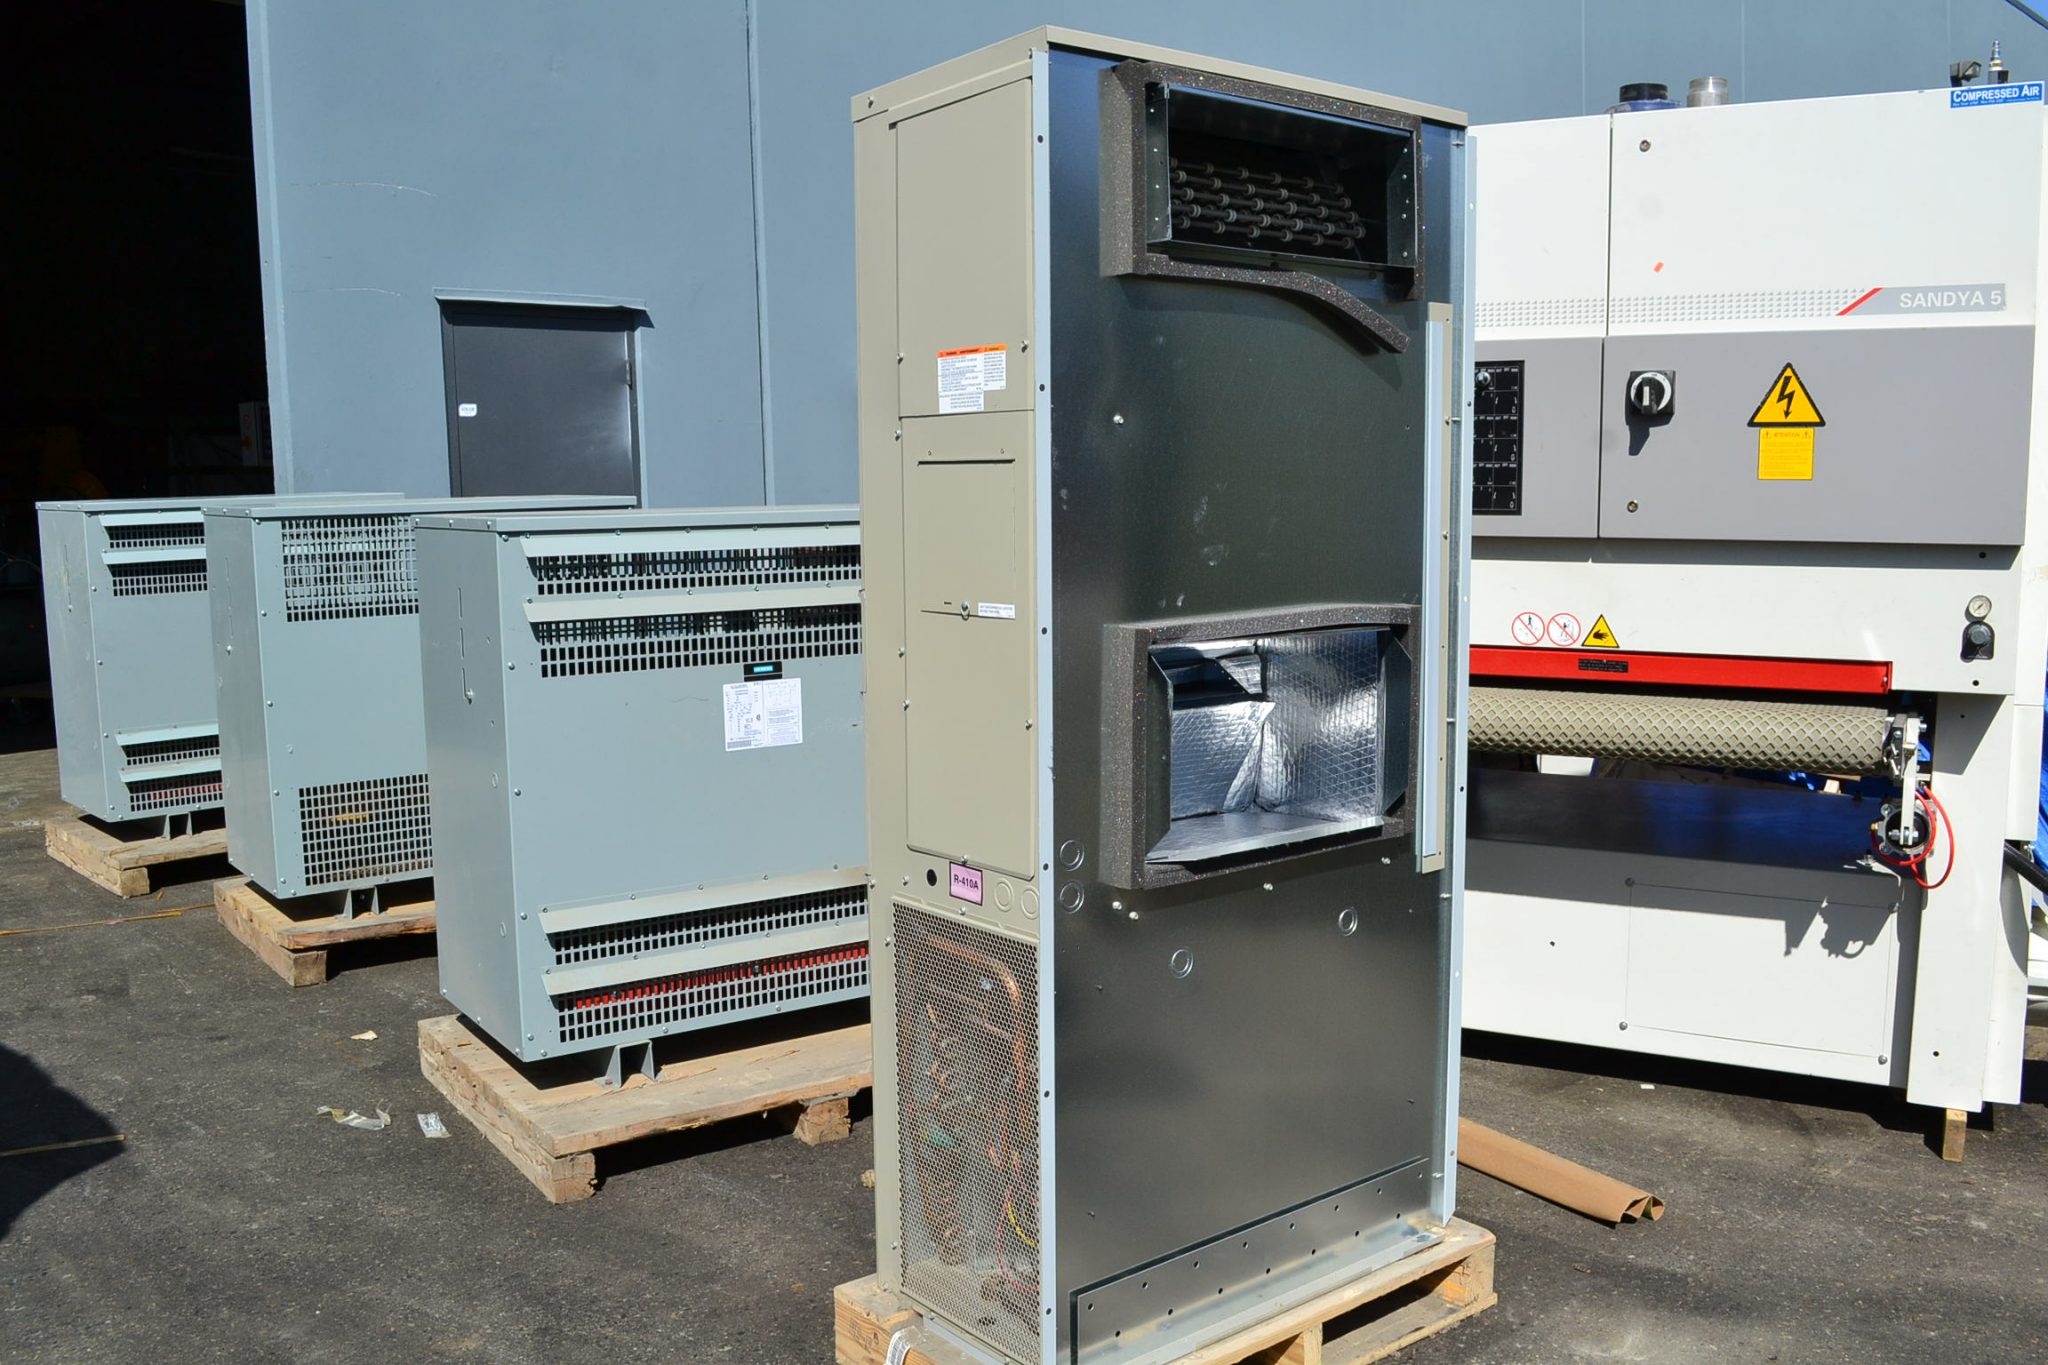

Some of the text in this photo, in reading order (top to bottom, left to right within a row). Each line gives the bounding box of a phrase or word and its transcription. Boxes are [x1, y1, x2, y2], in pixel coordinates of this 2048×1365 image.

[1953, 87, 2019, 102] COMPRESSED
[2021, 84, 2040, 97] AIR
[1899, 290, 2002, 308] SANDYA 5
[953, 874, 979, 890] R-410A
